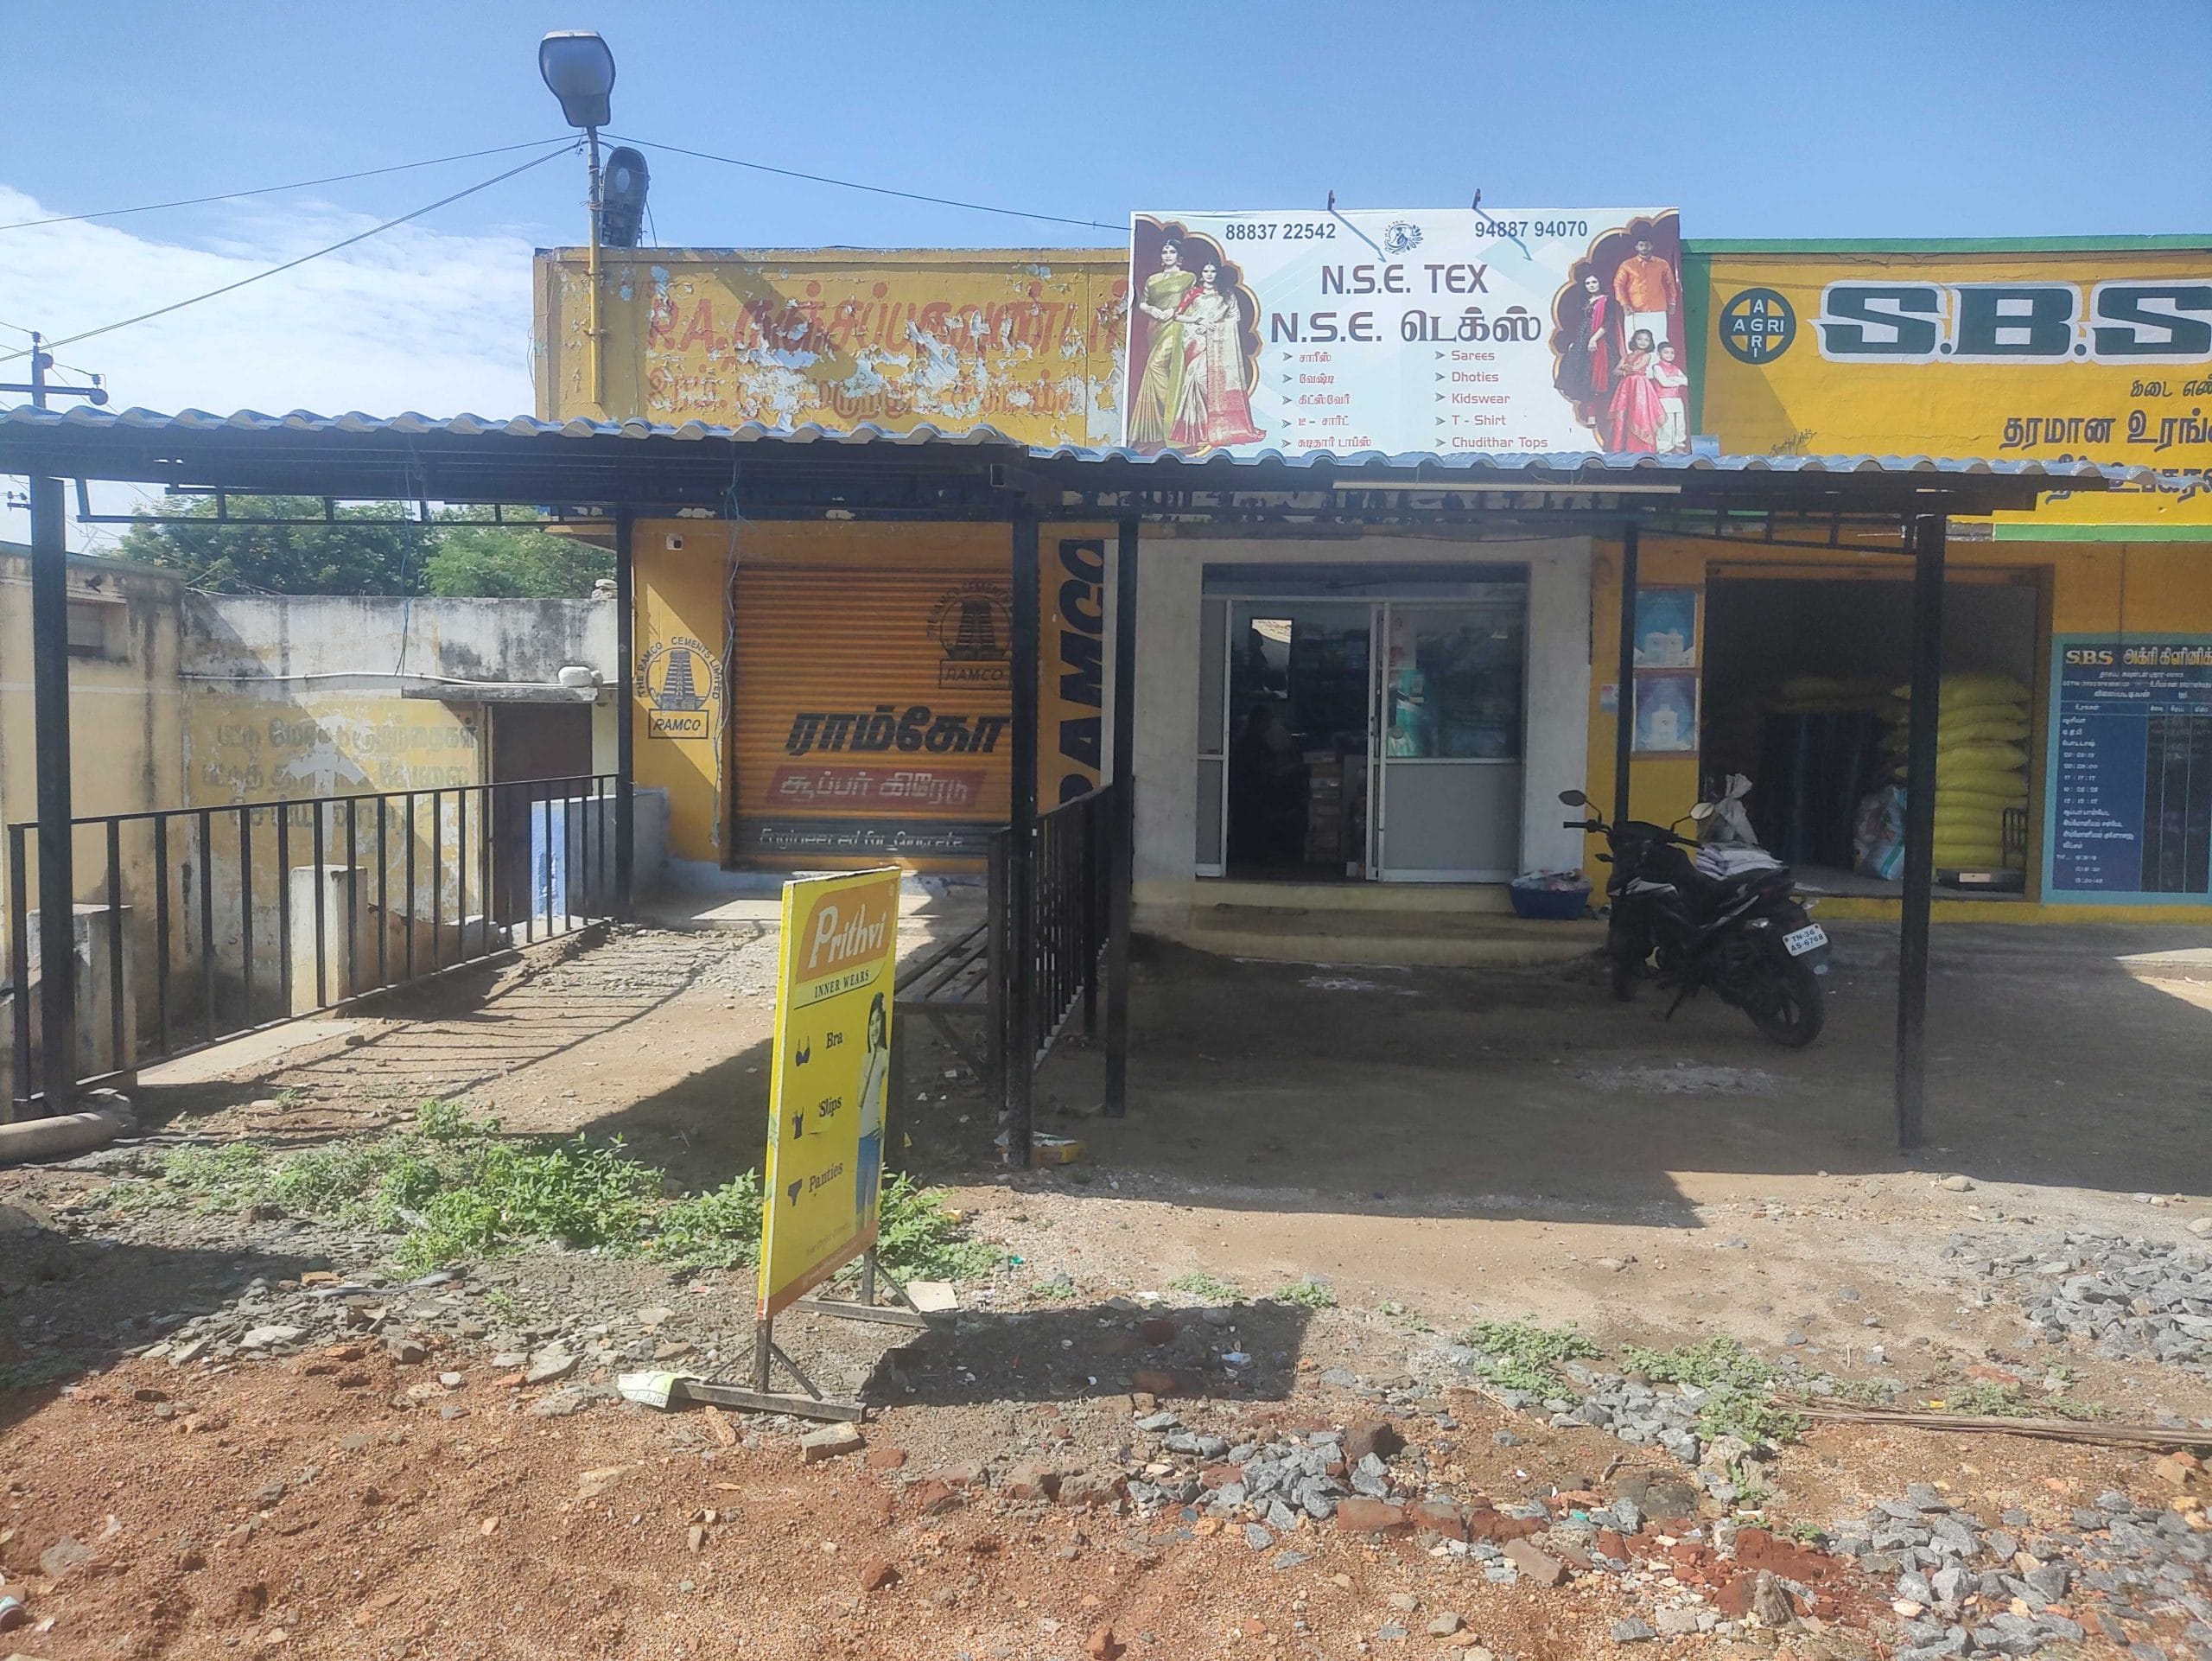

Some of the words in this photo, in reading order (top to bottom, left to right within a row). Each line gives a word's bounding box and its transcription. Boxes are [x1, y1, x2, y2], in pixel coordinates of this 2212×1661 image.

[1225, 224, 1277, 240] 88837
[1282, 223, 1336, 239] 22542
[1474, 221, 1528, 238] 94887
[1534, 220, 1588, 237] 94070
[1322, 264, 1410, 295] N.S.E.
[1424, 264, 1489, 294] TEX
[1271, 311, 1382, 343] N.S.E.
[1400, 305, 1541, 342] டெக்ஸ்
[1451, 350, 1495, 361] Sarees
[1452, 371, 1499, 382] Dhoties
[1452, 393, 1510, 404] Kidswear
[1452, 415, 1460, 425] T
[1474, 415, 1506, 426] Shirt
[1452, 436, 1514, 448] Chudithar
[1518, 436, 1548, 450] Tops
[1999, 417, 2116, 451] தரமான
[638, 642, 664, 671] RAMCO
[671, 636, 711, 659] CEMENTS
[652, 718, 702, 732] RAMCO
[785, 704, 1012, 757] ராம்கோ
[807, 903, 887, 969] Prithvi
[813, 980, 841, 999] INNER
[842, 969, 870, 988] WEARS
[825, 1031, 843, 1050] Bra
[819, 1095, 842, 1118] Slips
[808, 1161, 844, 1193] Panties
